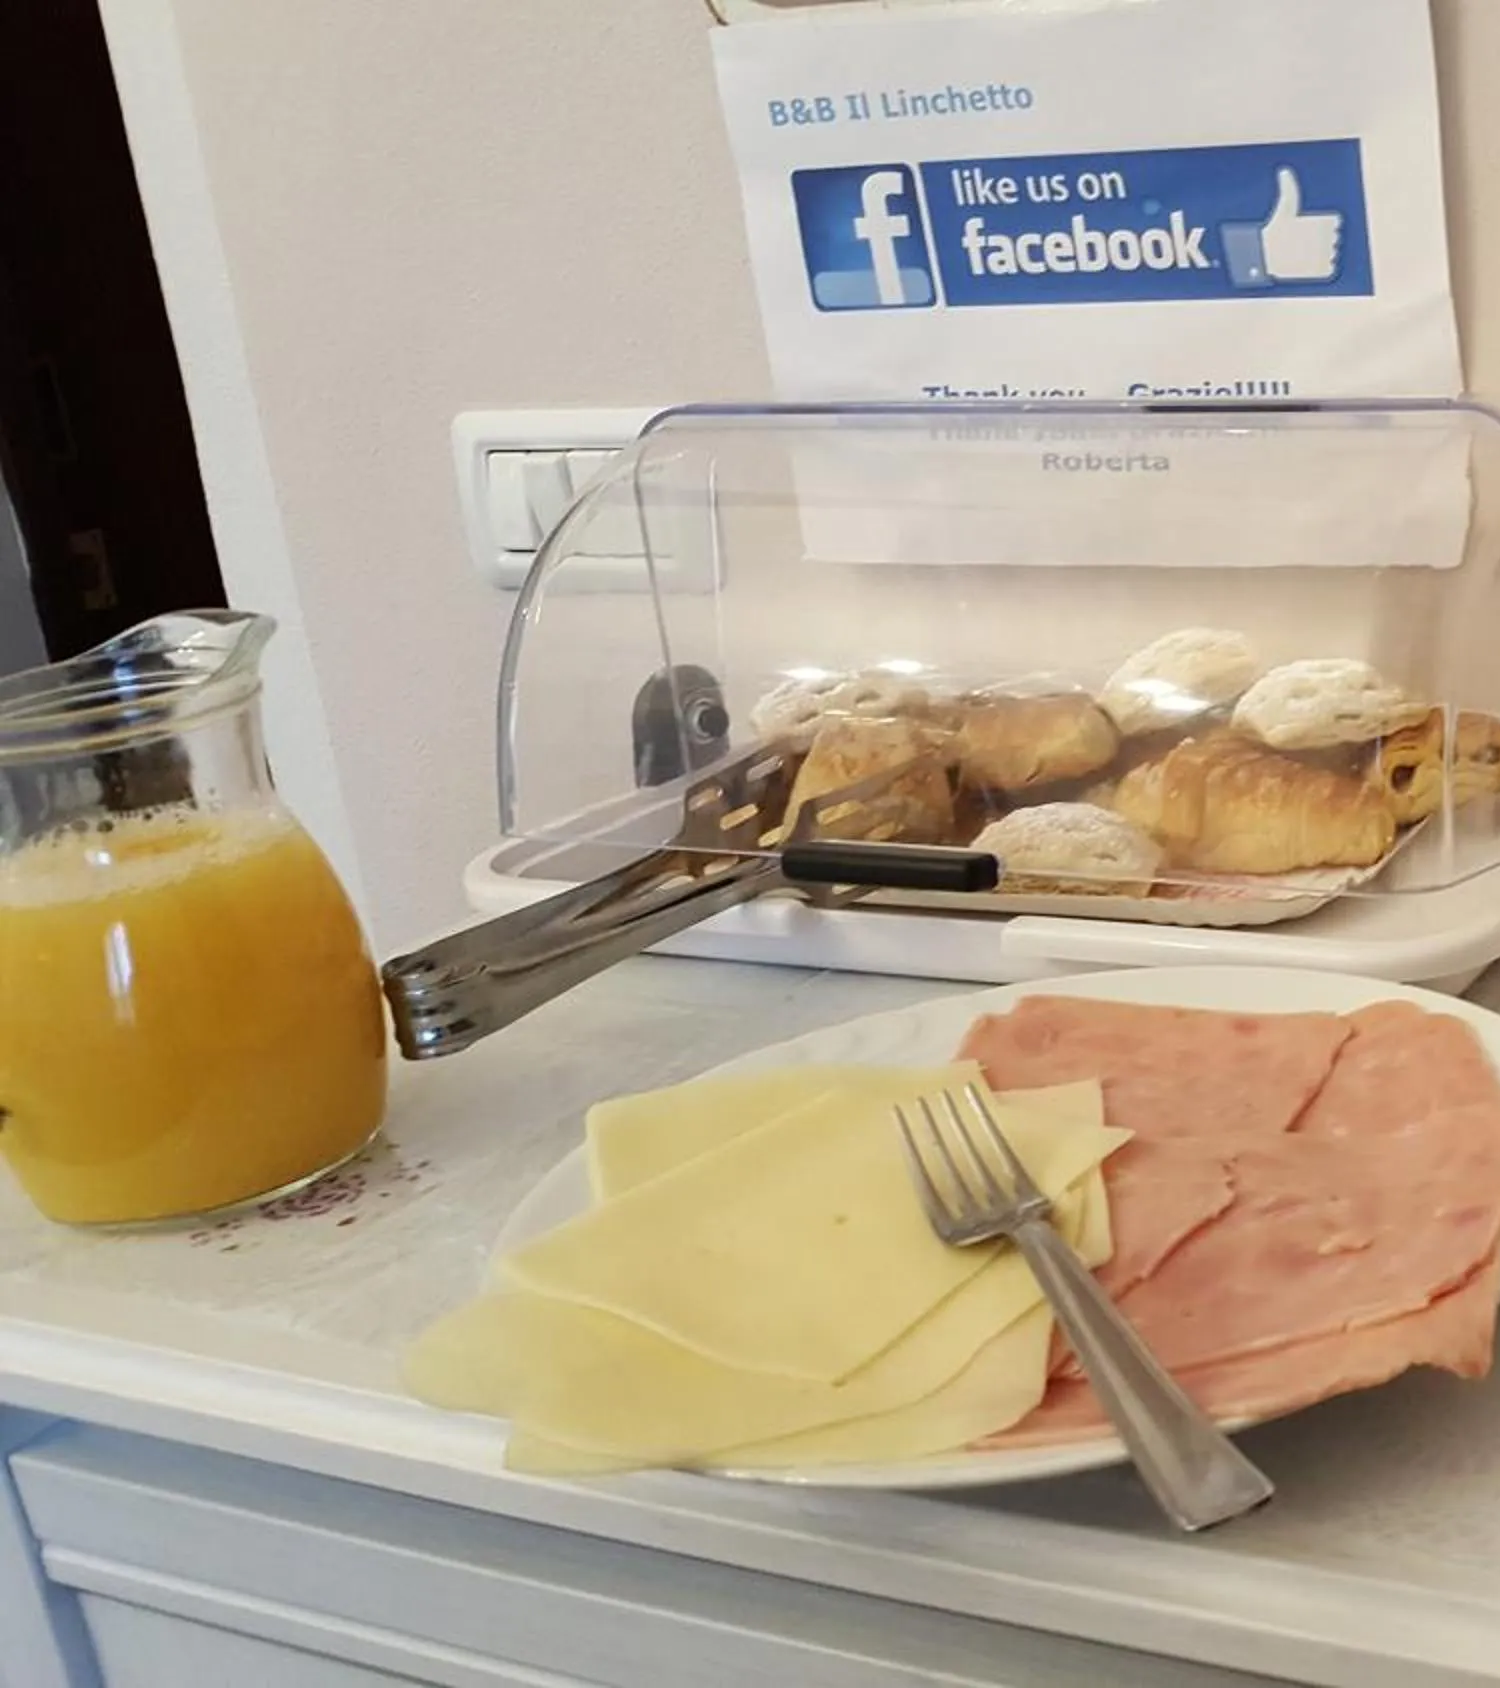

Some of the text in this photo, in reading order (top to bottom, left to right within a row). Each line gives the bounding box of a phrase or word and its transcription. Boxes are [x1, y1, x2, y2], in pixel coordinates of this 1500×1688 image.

[768, 84, 1034, 126] B&B Il Linchetto
[950, 167, 1126, 206] like us on
[961, 209, 1212, 276] facebook
[1041, 452, 1171, 472] Roberta
